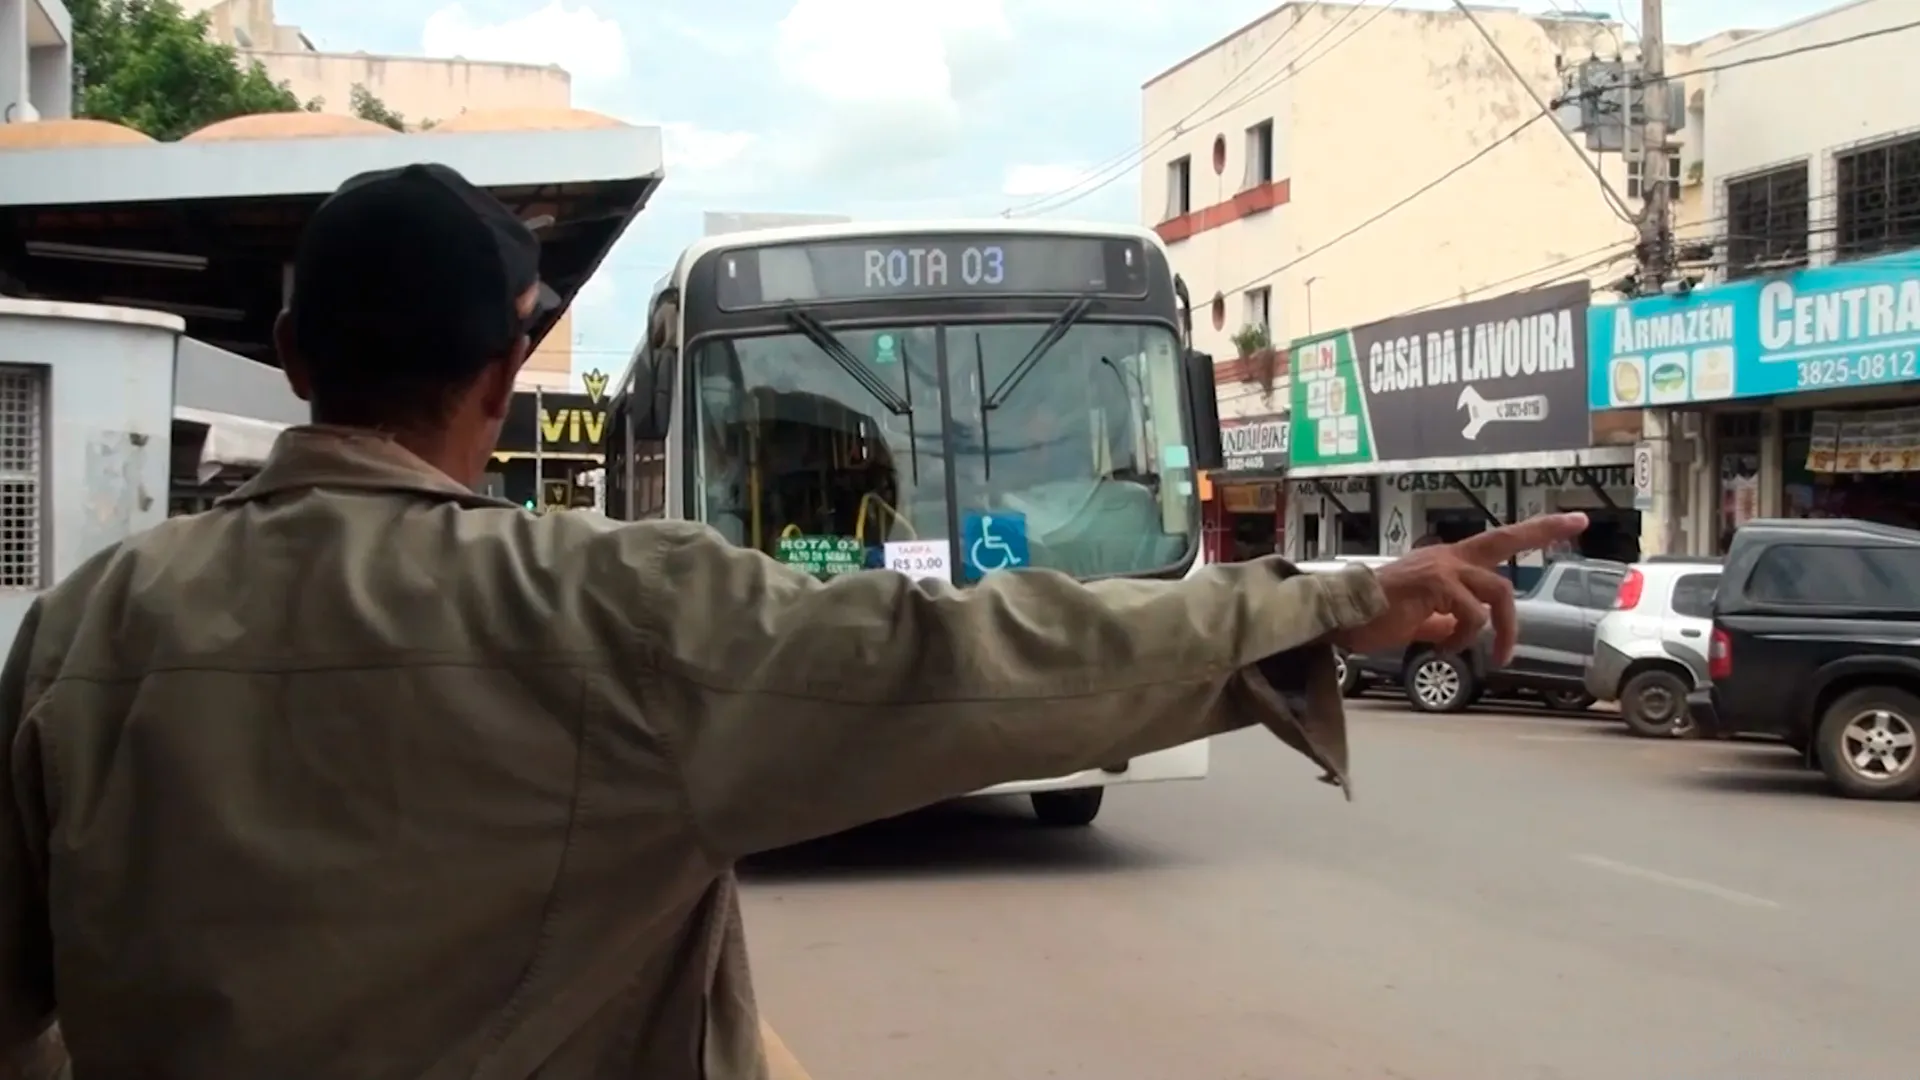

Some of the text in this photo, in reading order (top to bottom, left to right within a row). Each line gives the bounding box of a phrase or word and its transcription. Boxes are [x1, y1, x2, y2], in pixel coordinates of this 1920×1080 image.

[864, 245, 1004, 287] ROTA 03
[1613, 302, 1734, 354] ARMAZÉM
[1369, 335, 1423, 394] CASA
[1427, 329, 1457, 385] DA
[1460, 308, 1575, 381] LAVOURA
[1796, 350, 1916, 387] 3825-0812
[1260, 422, 1289, 452] BIKE
[1397, 472, 1455, 492] CASA
[1469, 471, 1502, 489] DA
[780, 539, 860, 551] ROTA 03
[811, 551, 823, 562] DA
[893, 558, 911, 571] R$
